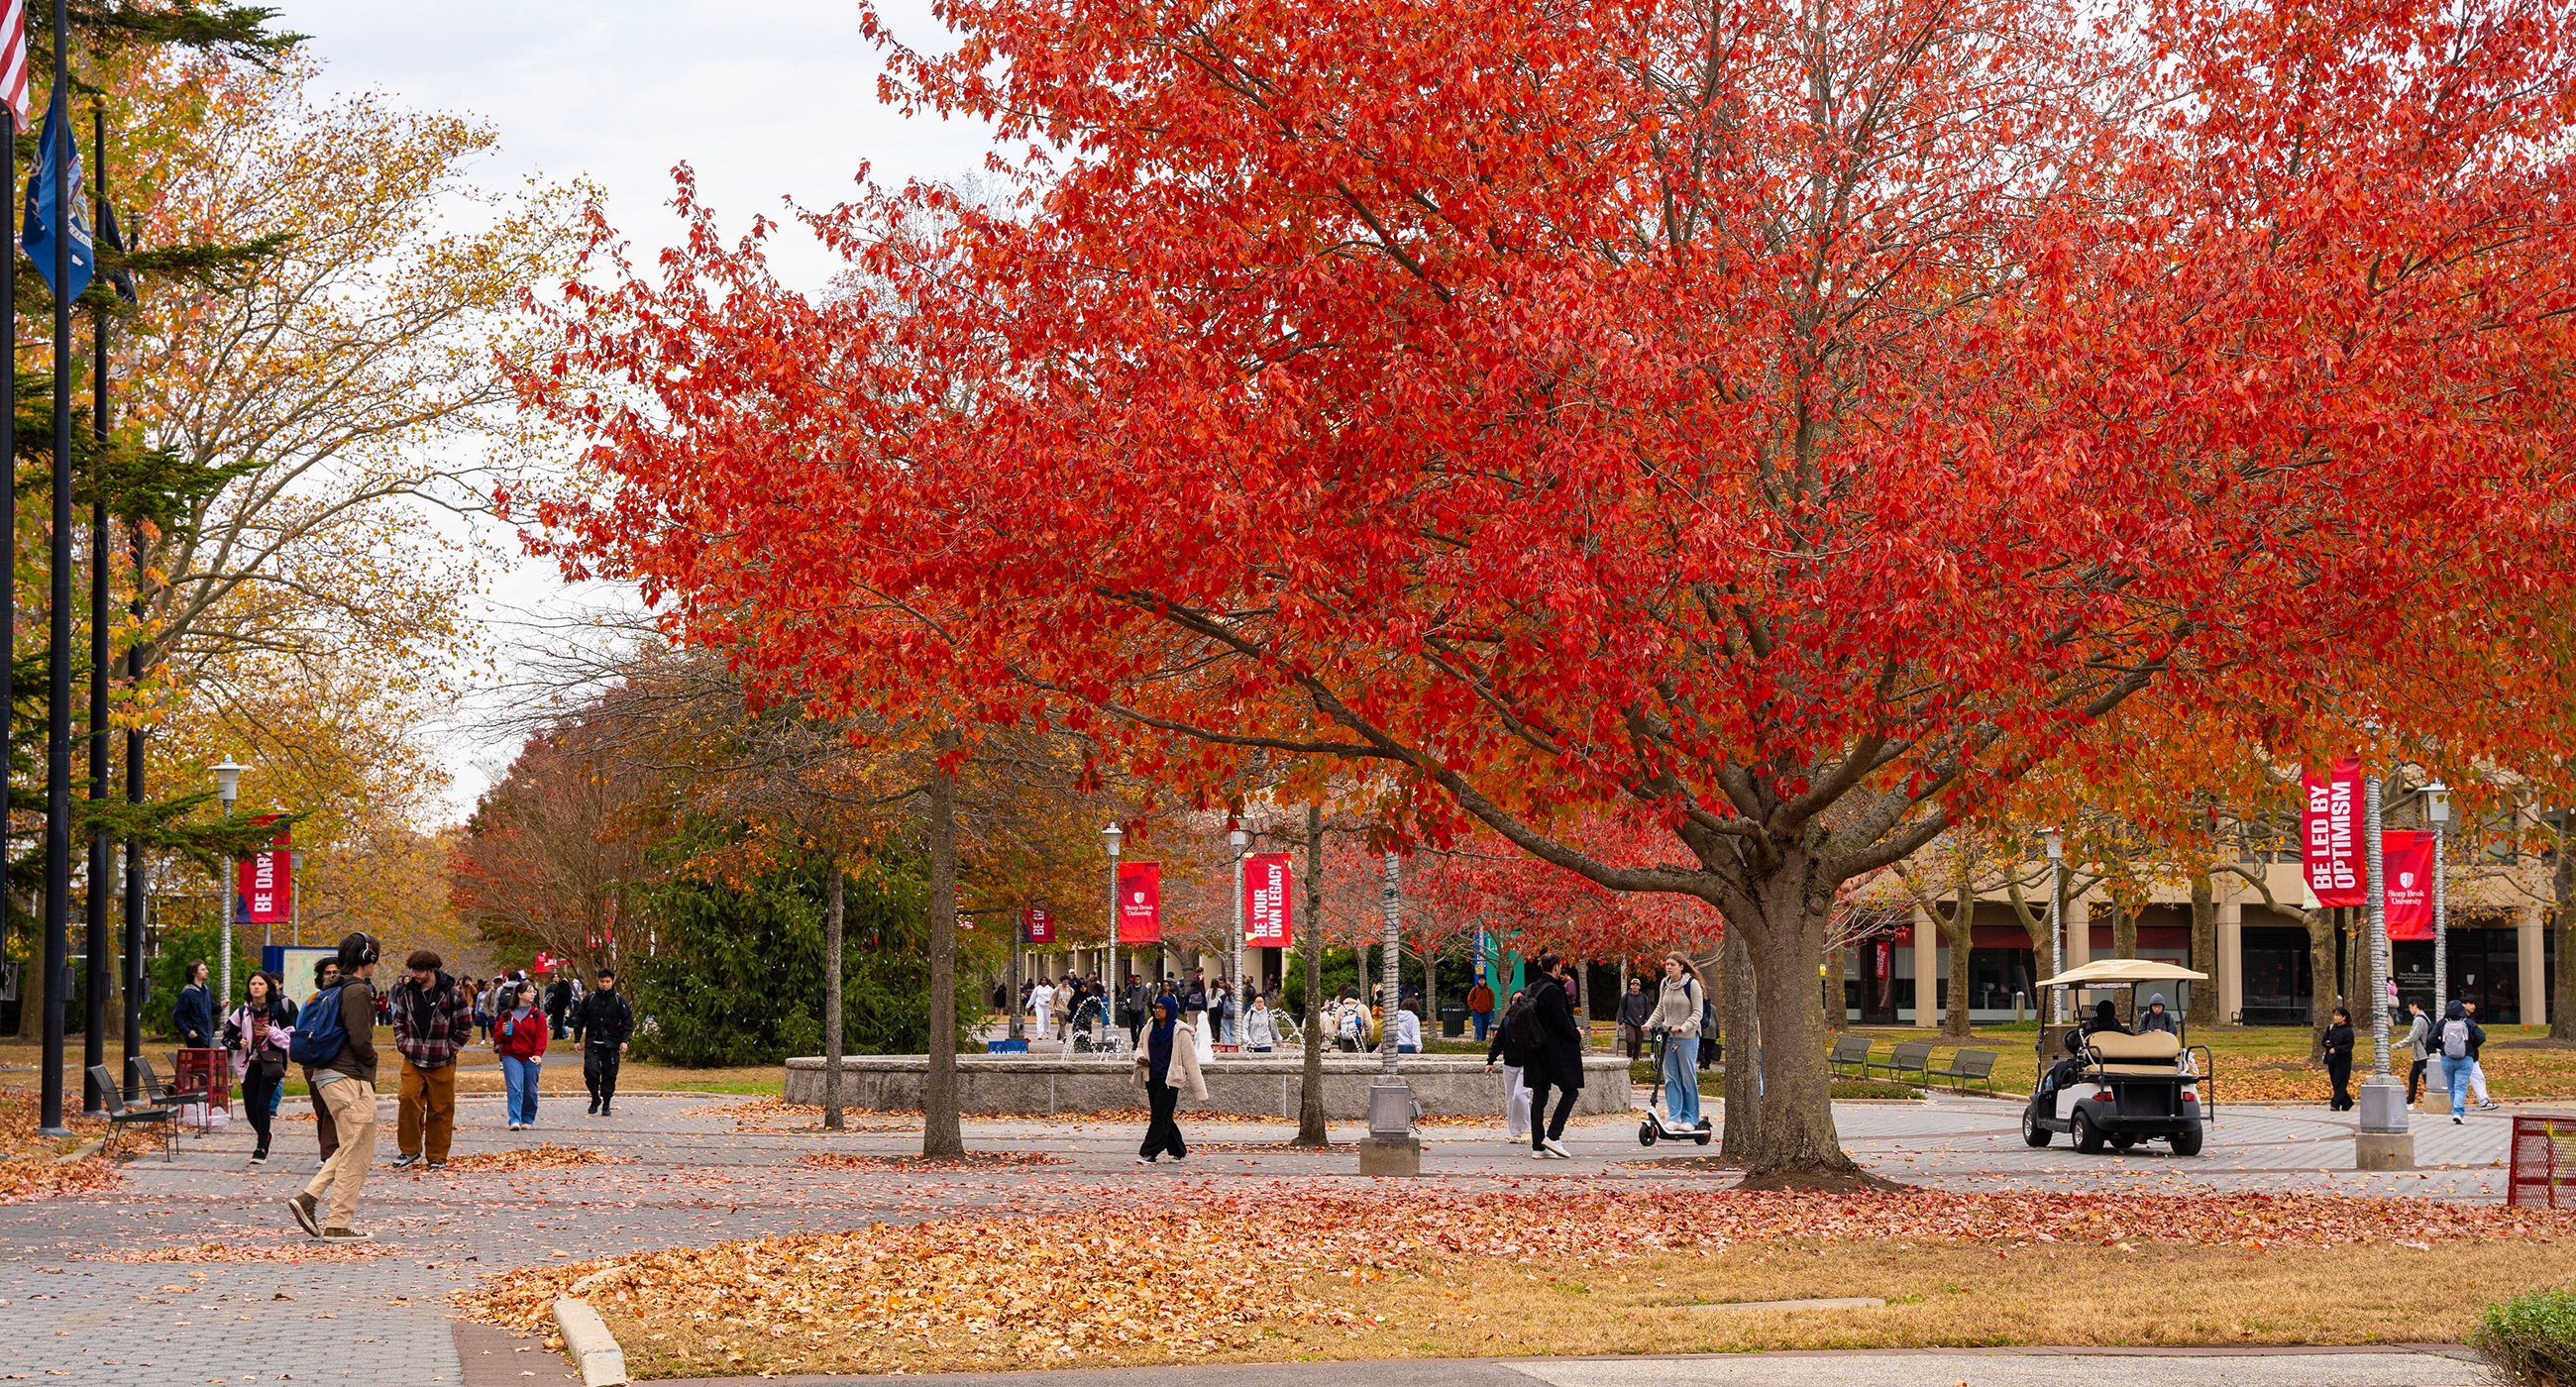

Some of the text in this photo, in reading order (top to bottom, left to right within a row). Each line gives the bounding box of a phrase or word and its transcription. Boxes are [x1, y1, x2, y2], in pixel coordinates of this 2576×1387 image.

[2310, 786, 2332, 890] BE LED BY
[2330, 782, 2356, 889] OPTIMISM
[254, 893, 272, 912] BE
[1268, 864, 1282, 937] OWN LEGACY
[2388, 890, 2406, 899] Stony
[2391, 897, 2421, 906] University
[1032, 922, 1044, 935] BE
[1254, 889, 1267, 937] BE YOUR
